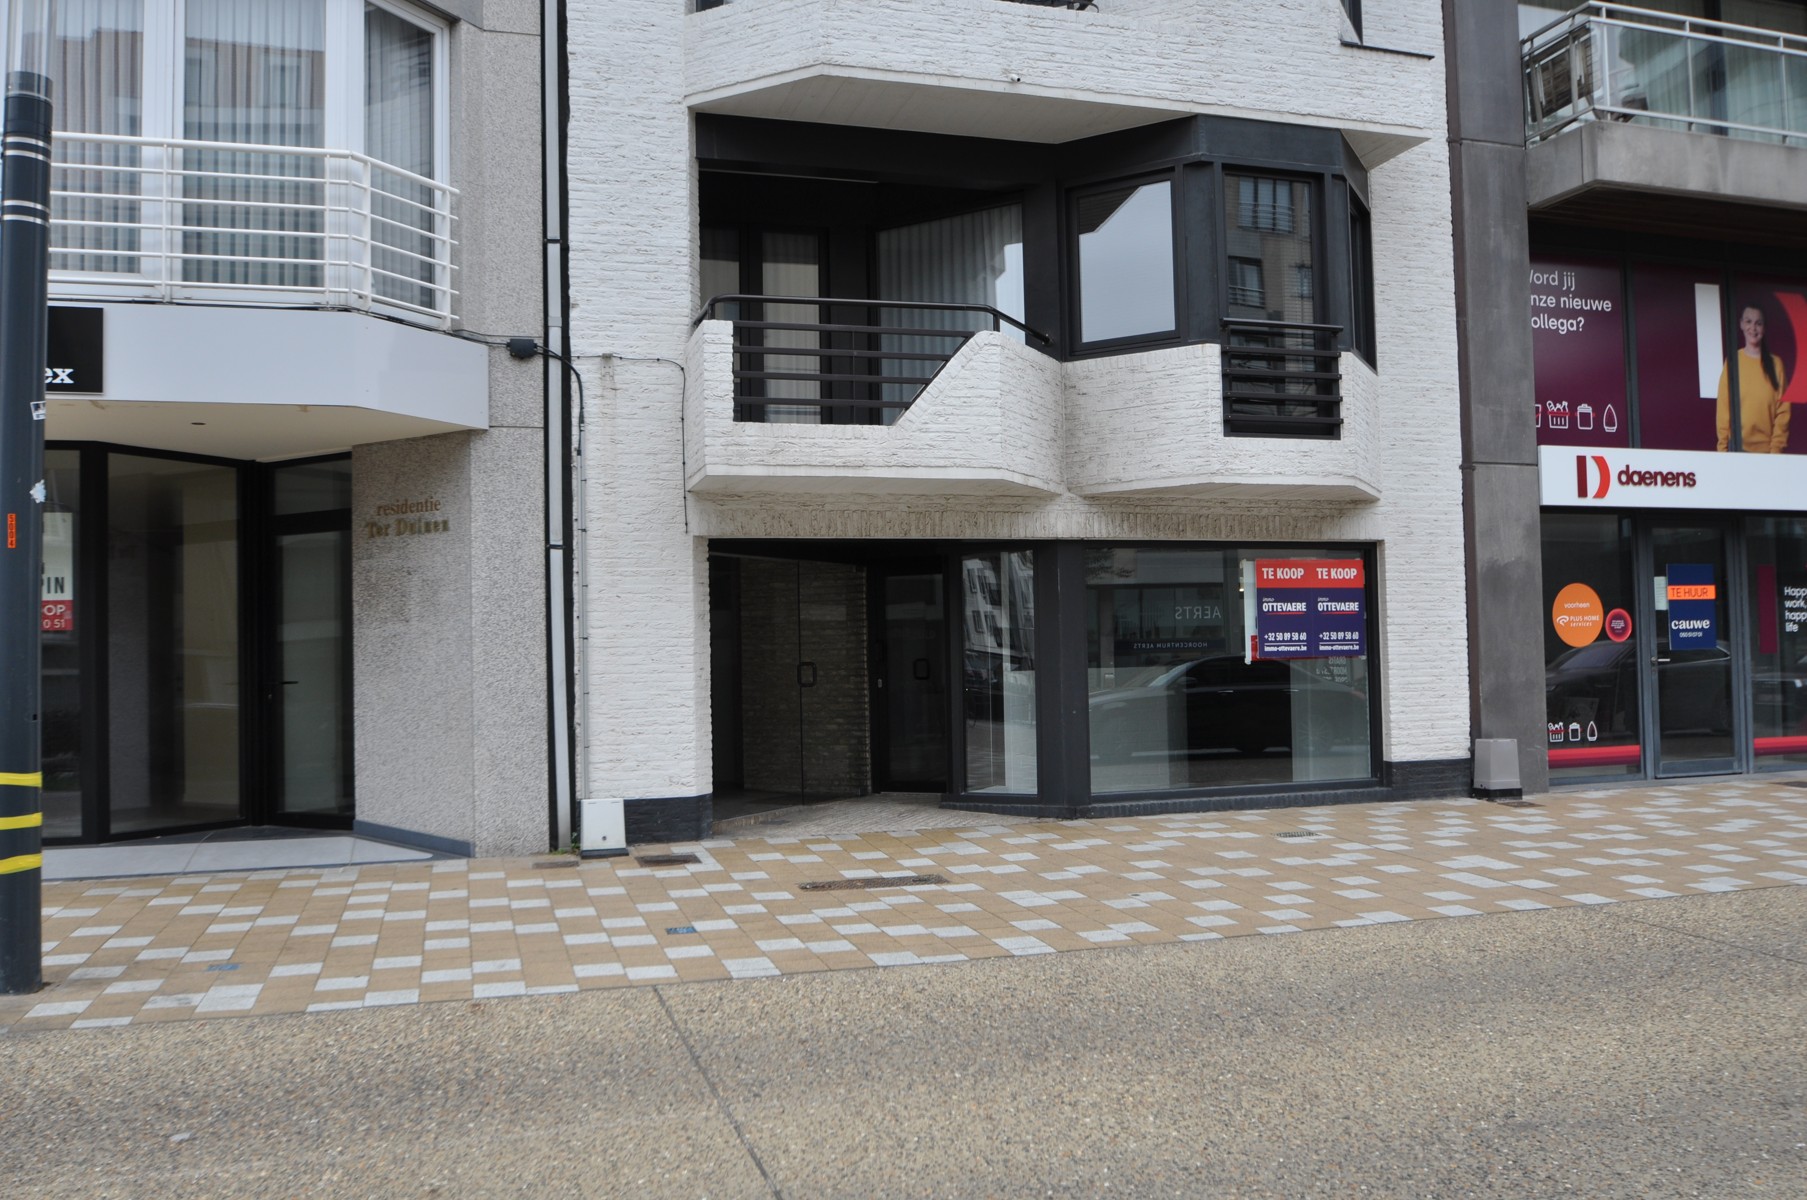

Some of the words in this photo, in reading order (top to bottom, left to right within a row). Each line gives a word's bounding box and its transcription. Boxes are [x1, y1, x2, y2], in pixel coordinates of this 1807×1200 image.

[1562, 271, 1575, 291] jij
[1530, 294, 1556, 308] nze
[1560, 293, 1612, 312] nieuwe
[1531, 313, 1585, 335] ollega?
[1617, 463, 1697, 488] daenens
[376, 496, 441, 516] residentie
[366, 520, 391, 538] Ter
[395, 517, 449, 537] Duinen
[1262, 567, 1274, 579] TE
[1276, 567, 1305, 579] KOOP
[1316, 567, 1329, 579] TE
[1330, 567, 1357, 579] KOOP
[41, 576, 65, 594] IN
[1670, 587, 1682, 598] TE
[1683, 587, 1709, 598] HUUR
[1784, 586, 1807, 599] Happ
[42, 604, 66, 616] OP
[1262, 602, 1307, 612] OTTEVAERE
[1317, 602, 1359, 611] OTTEVAERE
[1785, 610, 1807, 623] happ
[1671, 619, 1710, 630] cauwe
[1785, 622, 1799, 633] life
[1264, 632, 1276, 641] +32
[1276, 632, 1284, 641] 50
[1299, 632, 1307, 640] 60
[1319, 632, 1330, 640] +32
[1330, 631, 1337, 640] 50
[1352, 631, 1359, 640] 60
